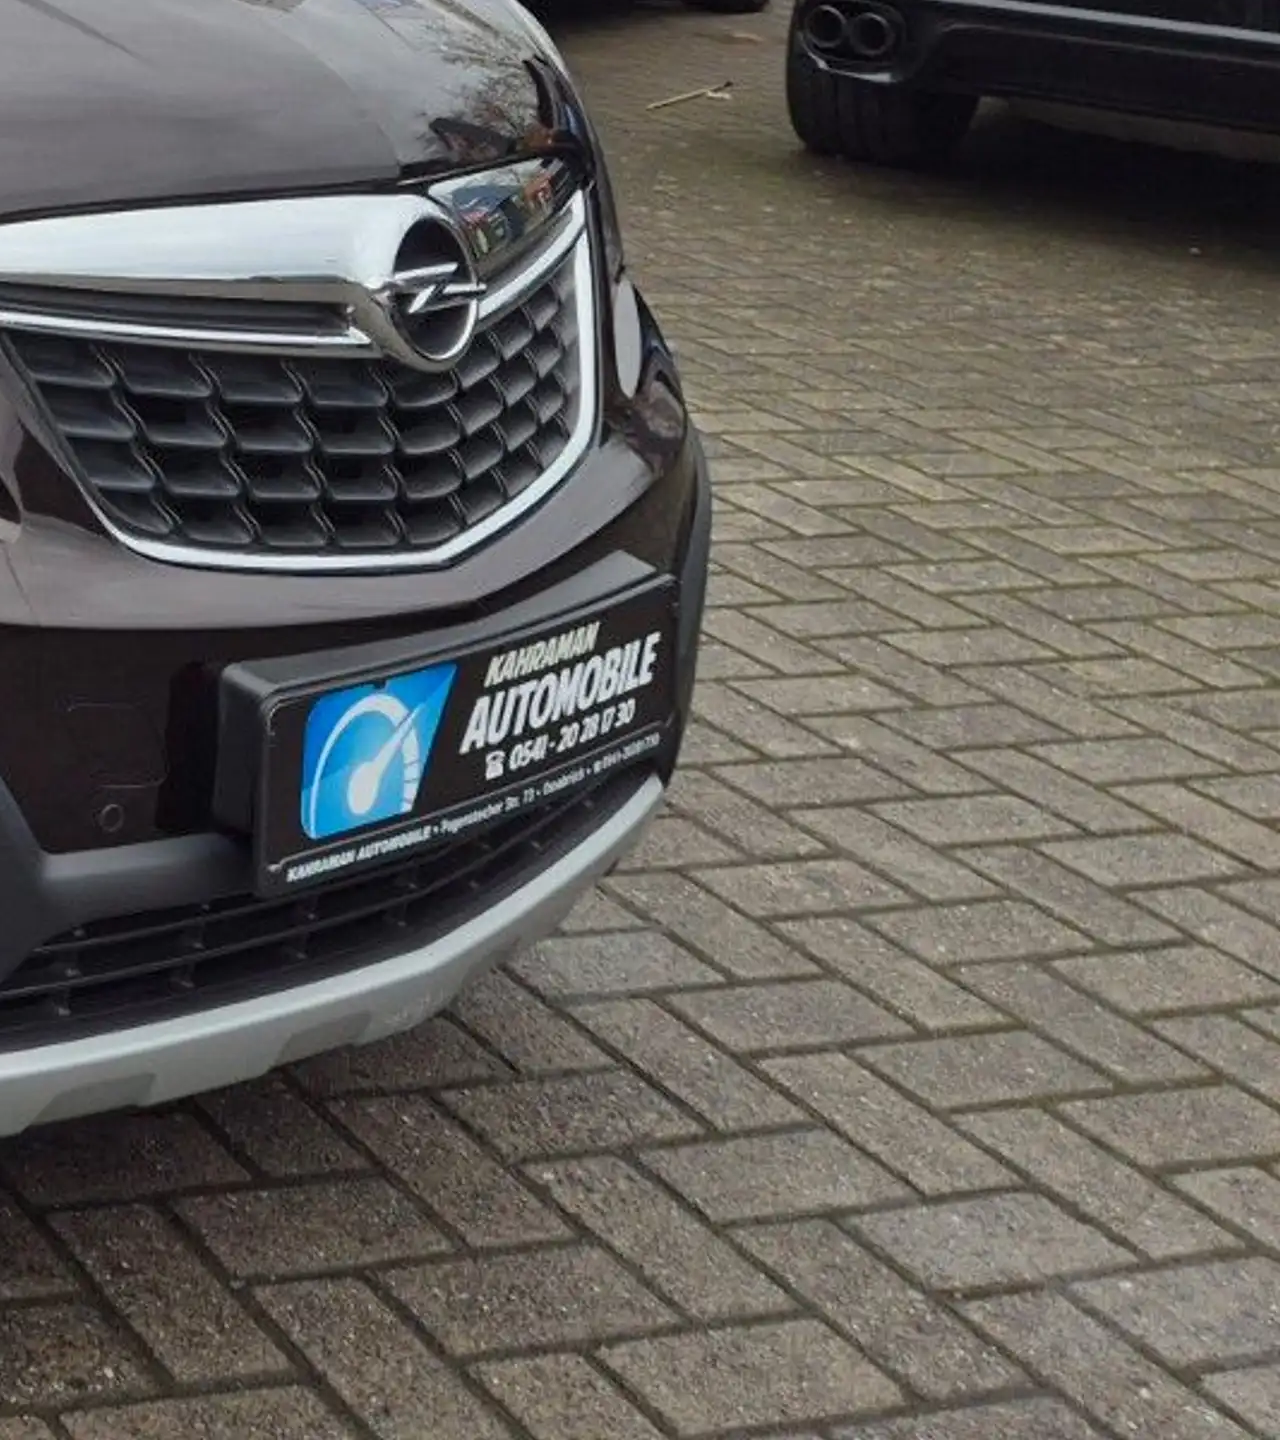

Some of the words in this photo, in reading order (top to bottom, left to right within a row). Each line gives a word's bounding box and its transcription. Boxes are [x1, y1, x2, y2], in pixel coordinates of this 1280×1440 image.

[484, 621, 601, 688] KAHRAMAN
[459, 631, 662, 755] AUTOMOBILE
[508, 734, 549, 771] 0541
